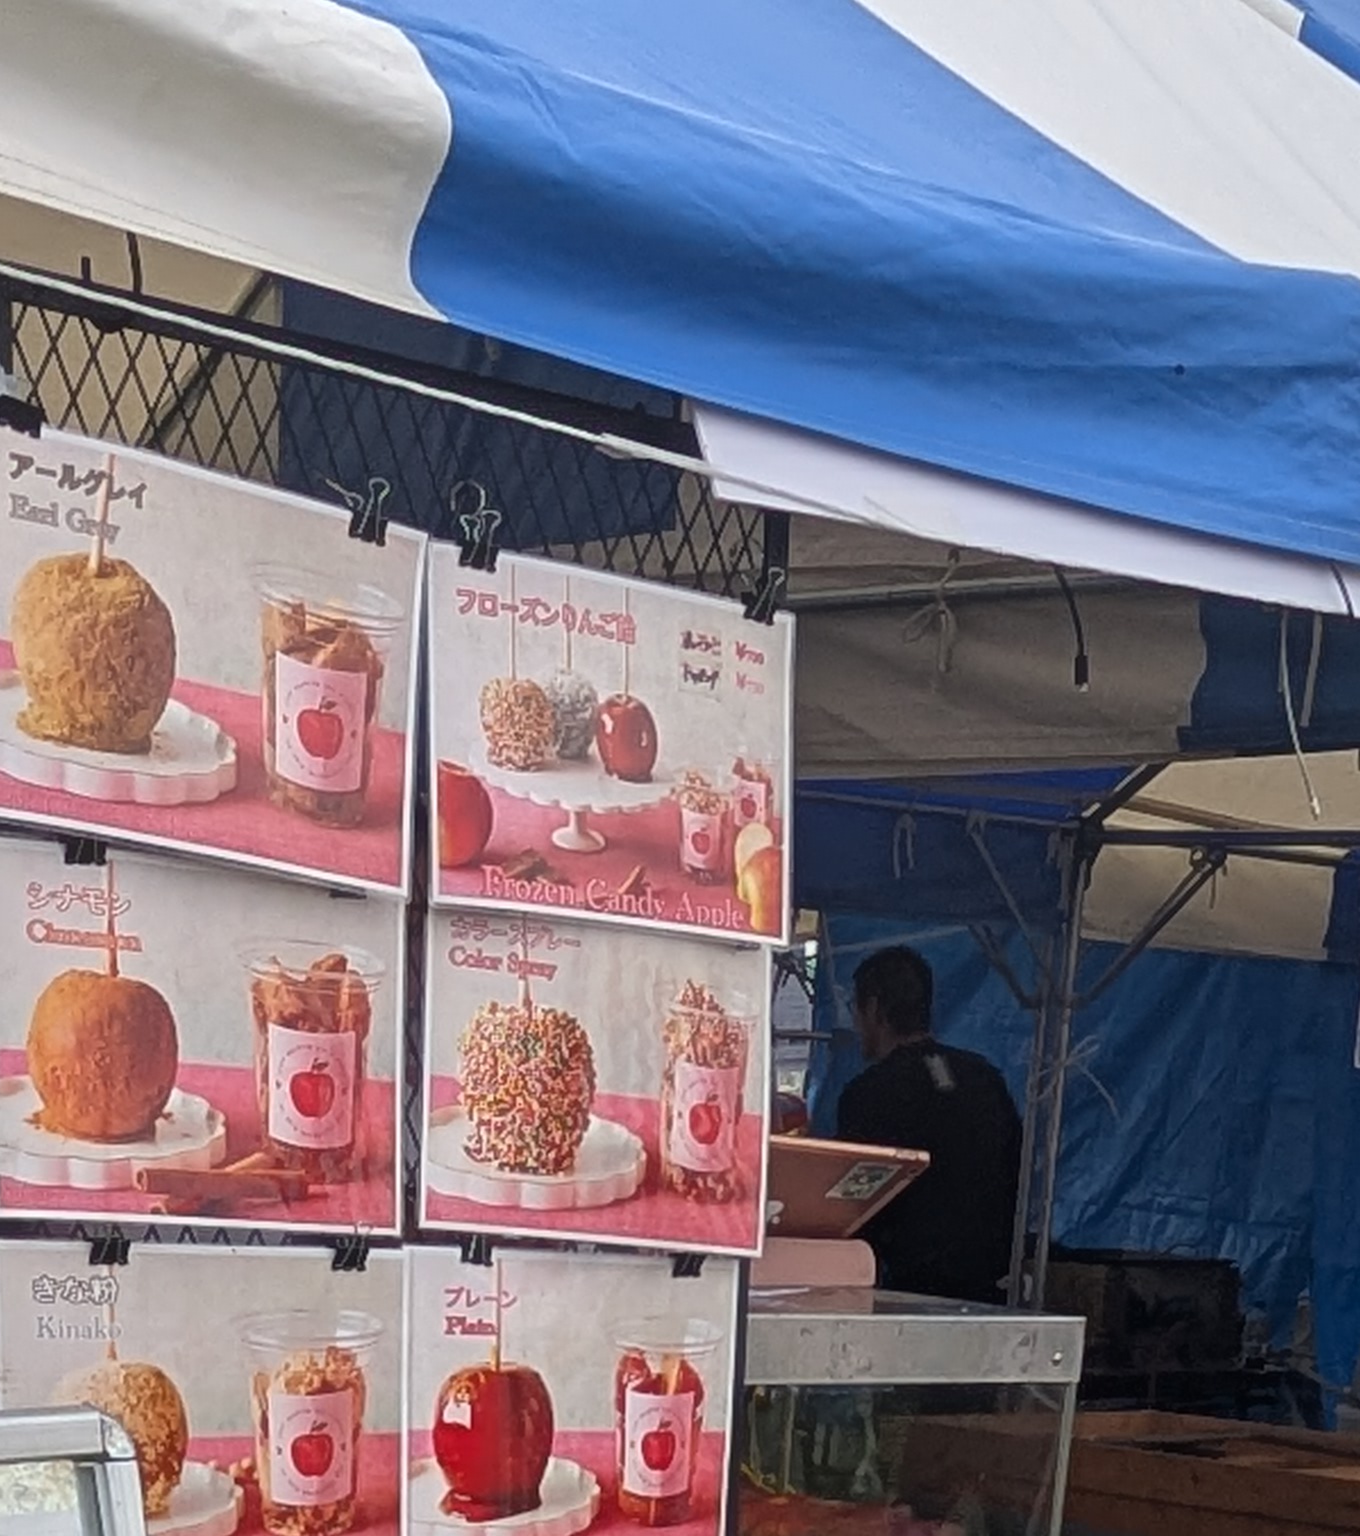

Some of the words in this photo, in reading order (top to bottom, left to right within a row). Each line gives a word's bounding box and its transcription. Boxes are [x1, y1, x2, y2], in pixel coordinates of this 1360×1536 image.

[26, 880, 132, 917] シナモン
[480, 863, 575, 905] Frozen
[585, 877, 666, 921] Candy
[674, 892, 746, 930] Apple
[447, 944, 503, 972] Color
[36, 1316, 122, 1339] Kinako
[444, 1315, 500, 1336] Plain
